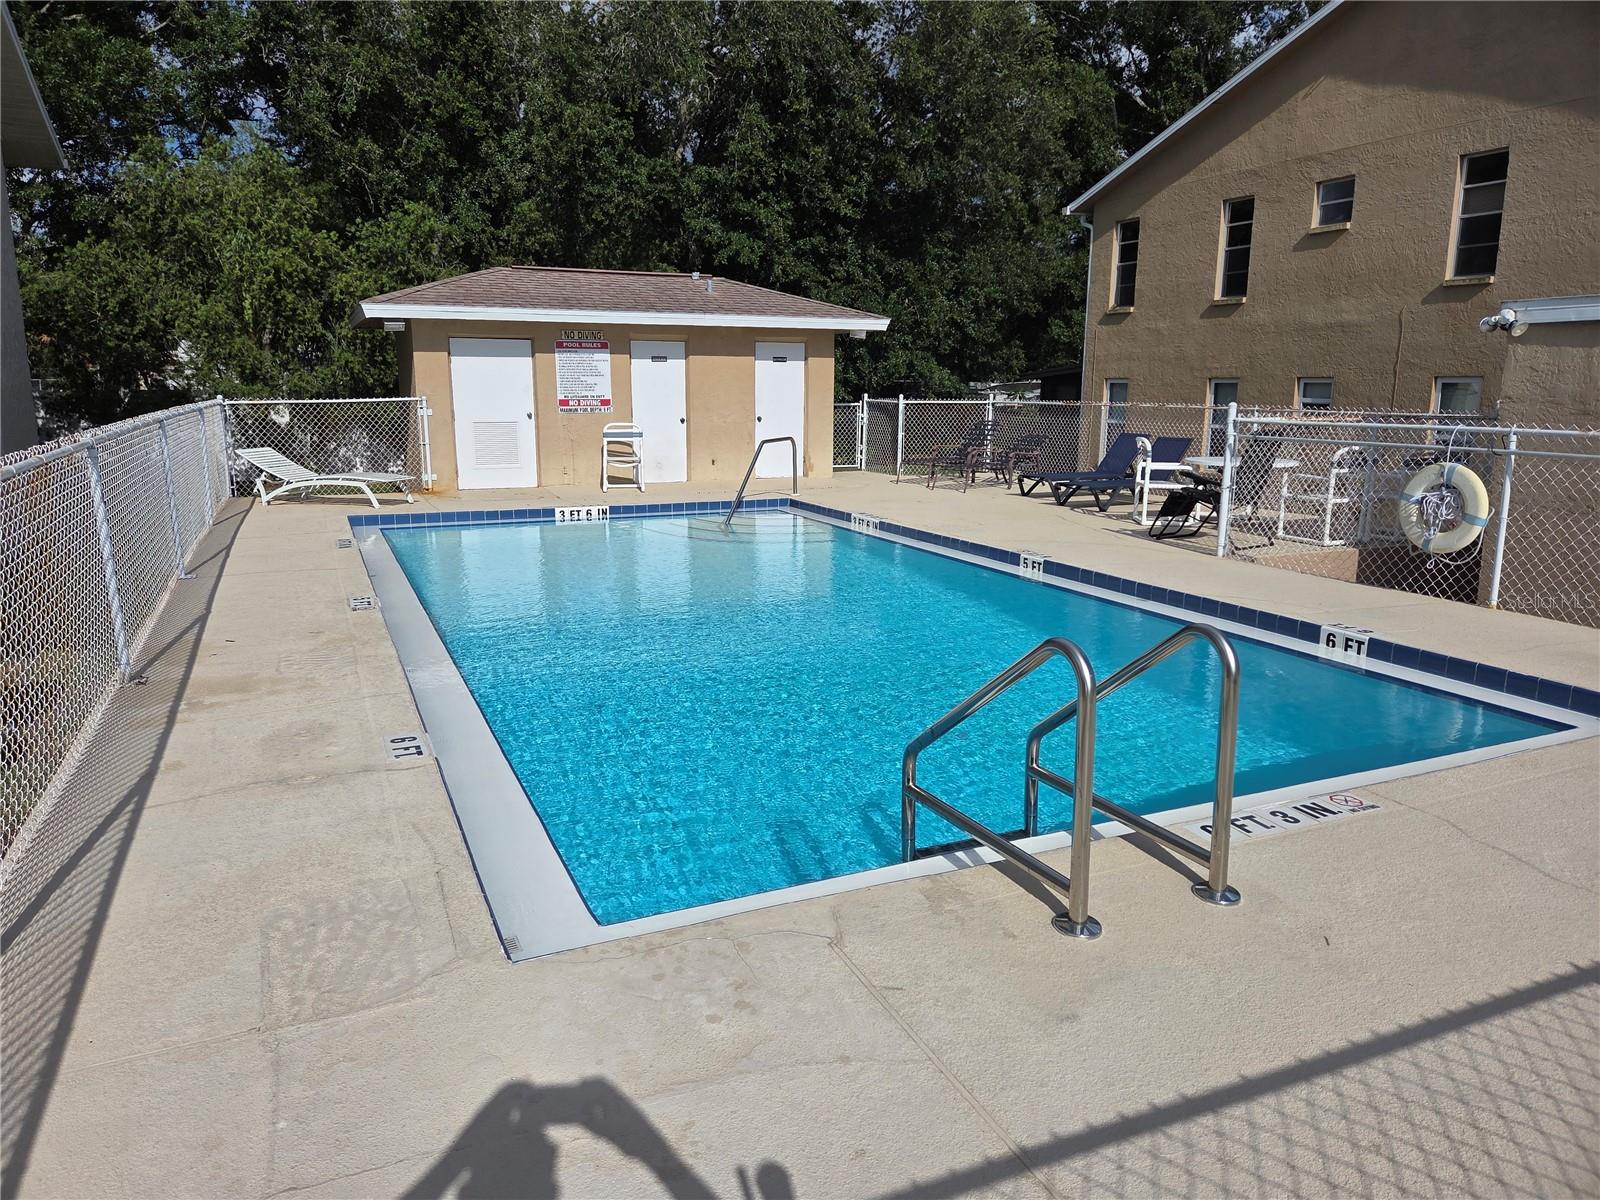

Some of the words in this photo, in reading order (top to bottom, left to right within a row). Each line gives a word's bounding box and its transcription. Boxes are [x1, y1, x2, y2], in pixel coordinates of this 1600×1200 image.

[564, 331, 574, 339] NO
[577, 331, 602, 340] DIVING
[560, 510, 566, 522] 3
[598, 508, 608, 520] IN
[1023, 558, 1028, 568] 5
[1032, 560, 1042, 572] FT
[1326, 632, 1336, 648] 6
[1344, 637, 1366, 656] FT
[392, 745, 424, 759] FT
[1270, 810, 1300, 824] 3
[1292, 802, 1344, 819] IN.
